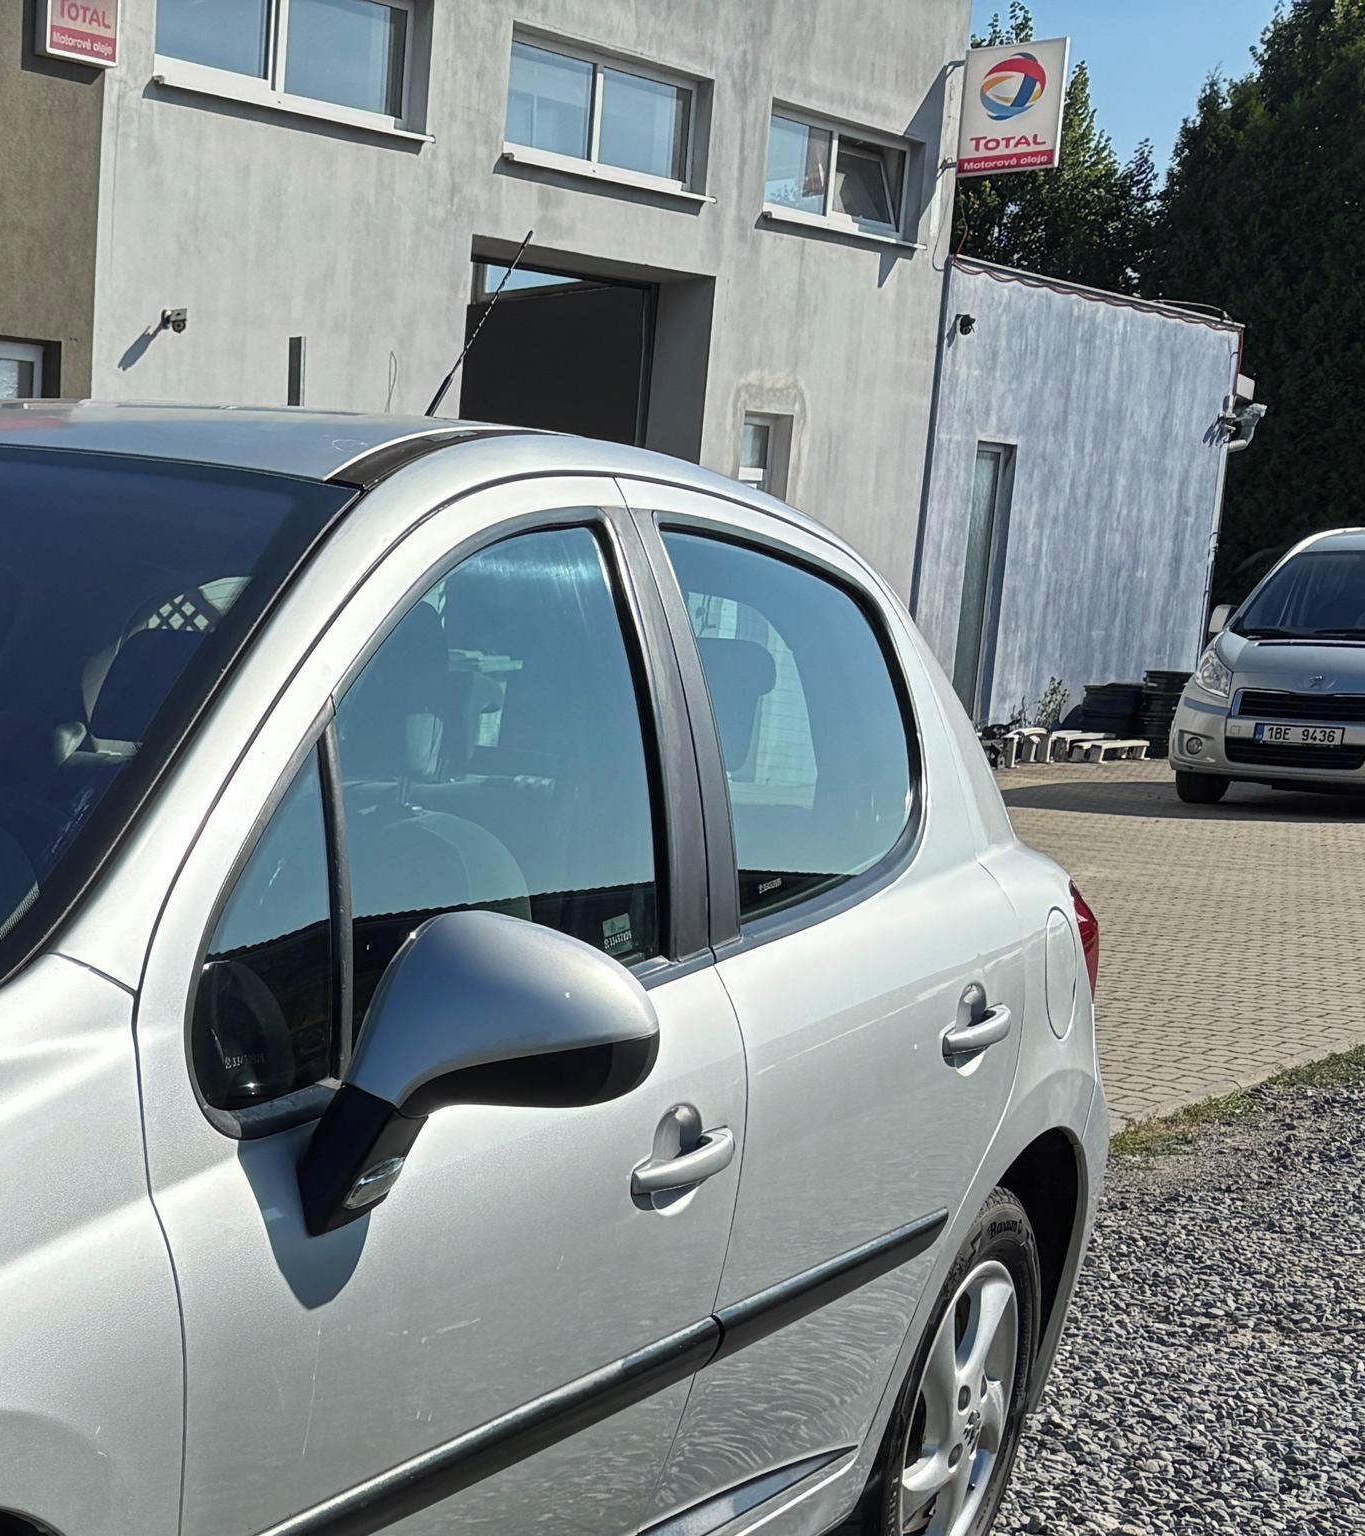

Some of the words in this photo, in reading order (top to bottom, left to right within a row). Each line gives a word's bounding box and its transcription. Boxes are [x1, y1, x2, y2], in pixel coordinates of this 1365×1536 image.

[969, 133, 1047, 152] TOTAL
[963, 156, 1018, 170] Motorové
[1020, 154, 1048, 164] oleje
[1267, 726, 1291, 741] 1BE
[1301, 728, 1336, 743] 9436
